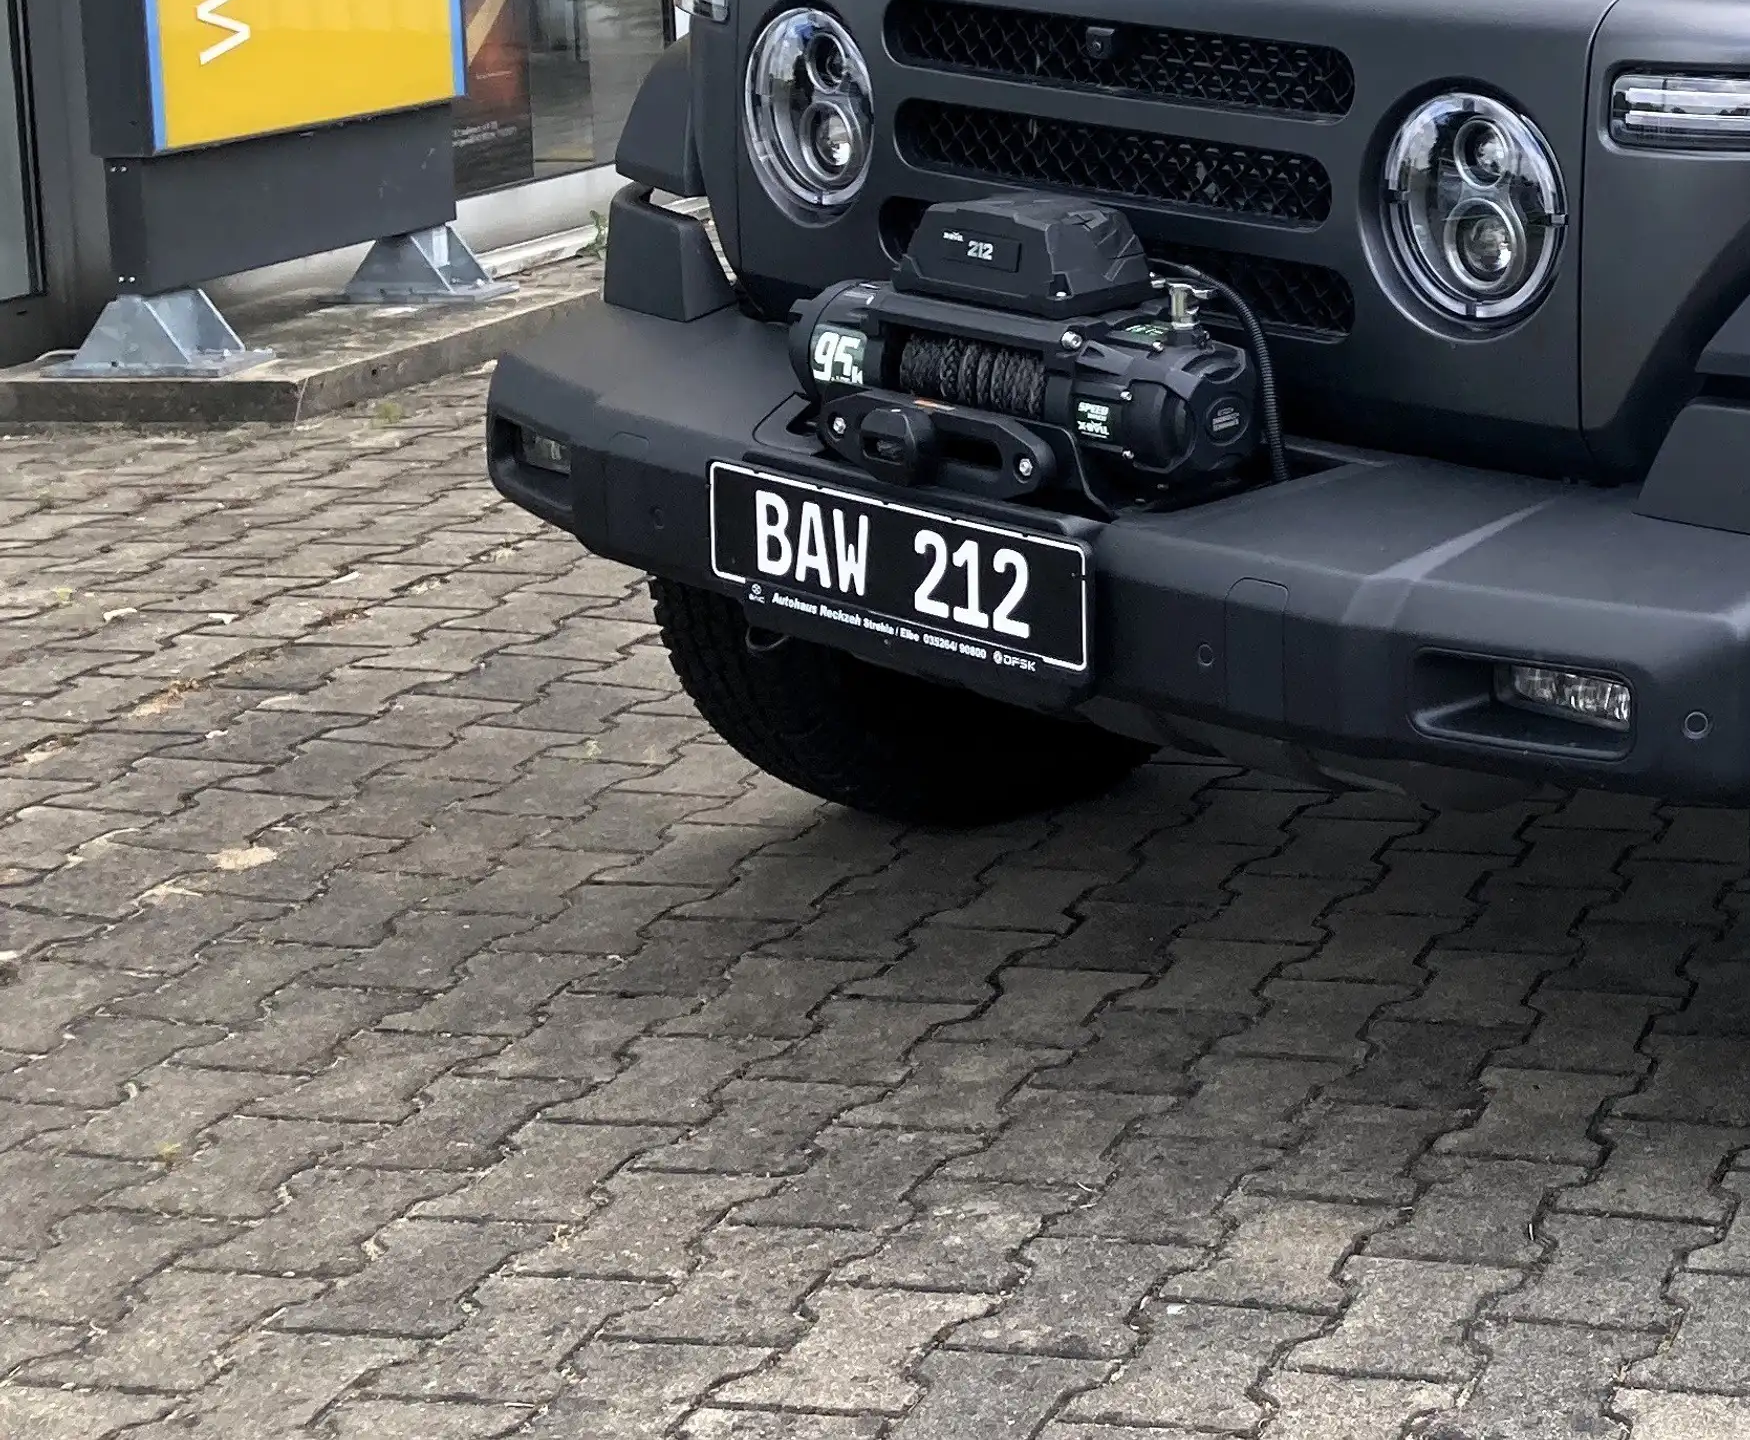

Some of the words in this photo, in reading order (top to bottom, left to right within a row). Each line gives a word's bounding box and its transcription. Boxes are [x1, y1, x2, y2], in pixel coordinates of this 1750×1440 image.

[967, 240, 994, 261] 212
[755, 490, 869, 596] BAW
[914, 529, 1030, 639] 212
[771, 592, 818, 614] Autohaus
[819, 604, 862, 626] Reckzeh
[1003, 654, 1036, 672] DFSK
